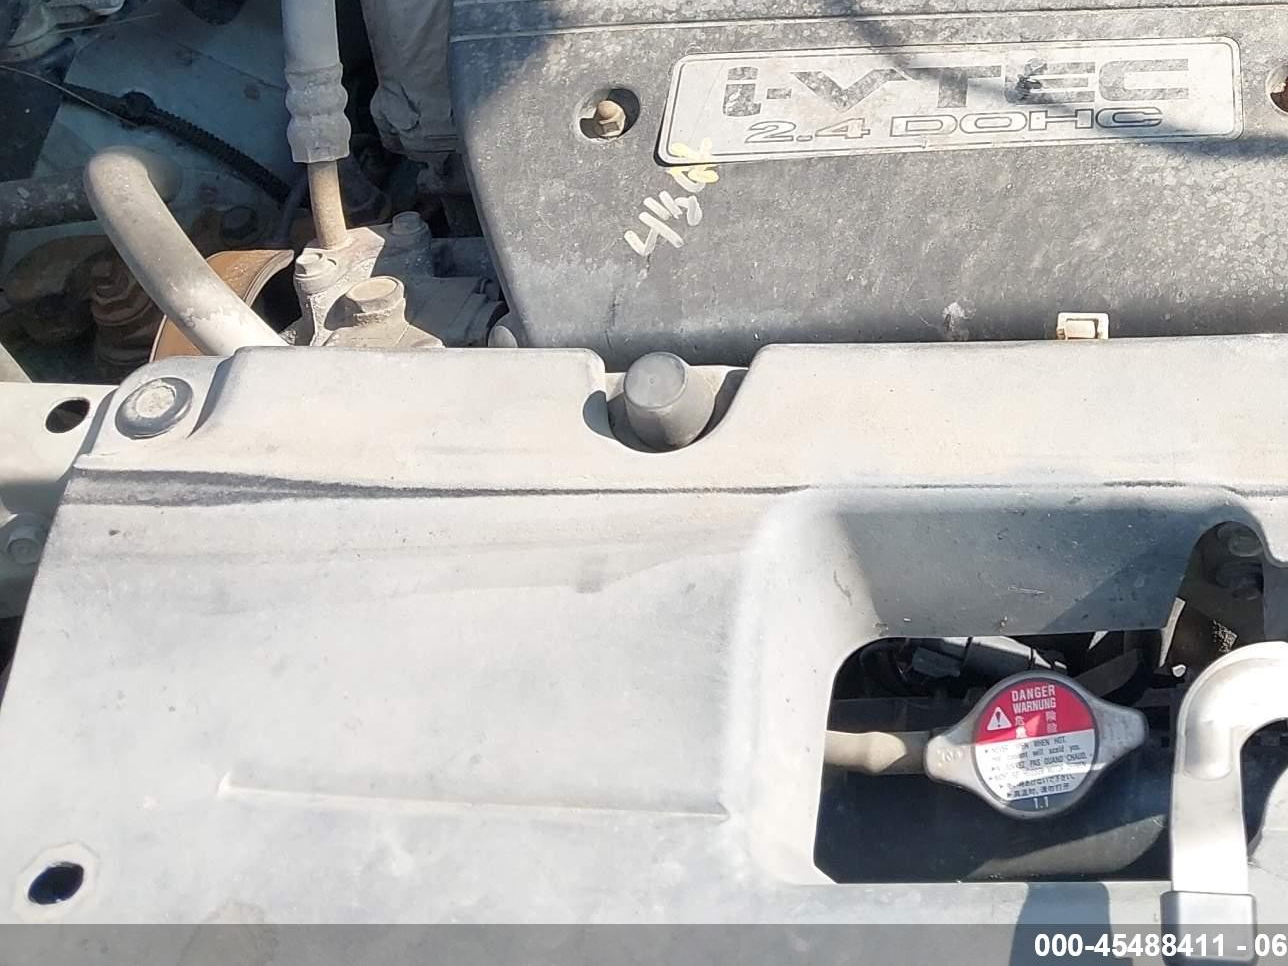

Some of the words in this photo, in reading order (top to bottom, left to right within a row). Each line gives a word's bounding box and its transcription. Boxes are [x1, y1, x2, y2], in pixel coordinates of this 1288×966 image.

[722, 57, 1190, 118] i-VTEC
[744, 116, 871, 144] 2.4
[890, 106, 1164, 138] DOHC
[1011, 684, 1056, 702] DANGER
[1012, 697, 1057, 715] WARNUNG
[1033, 795, 1049, 810] 1.1
